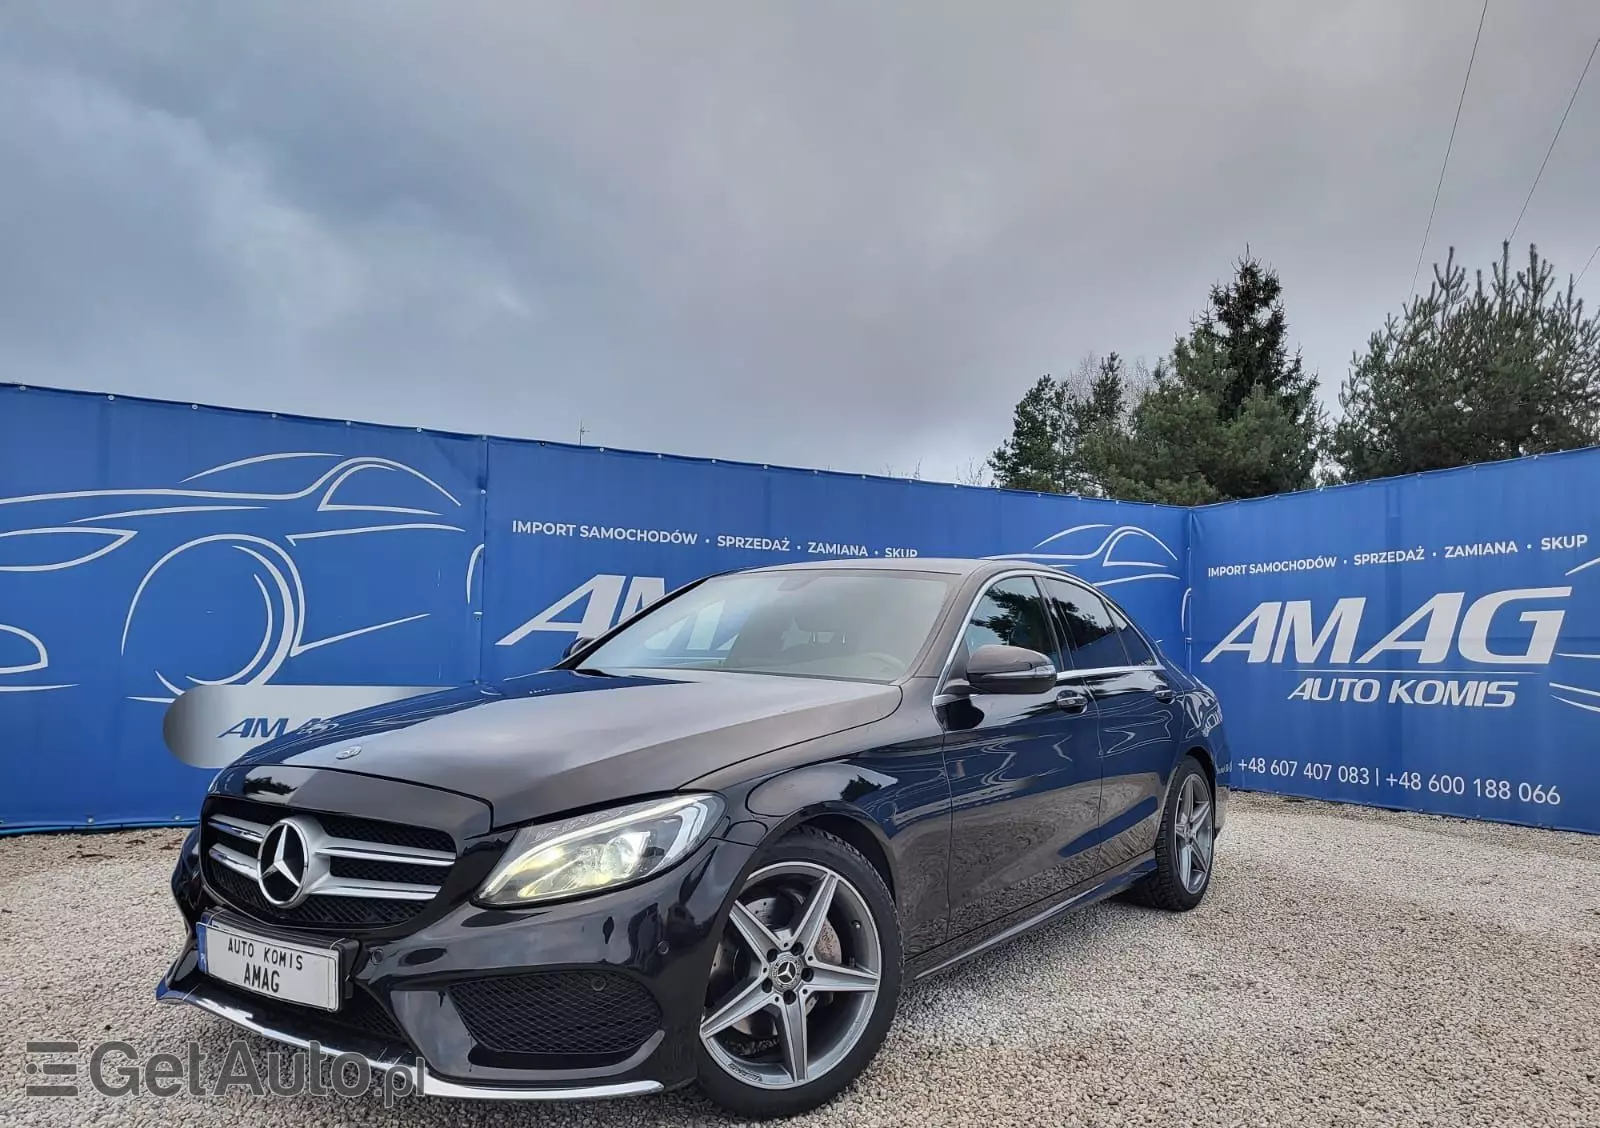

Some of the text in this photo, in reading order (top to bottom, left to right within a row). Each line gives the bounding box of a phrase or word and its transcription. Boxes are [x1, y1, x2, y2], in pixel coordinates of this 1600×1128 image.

[512, 520, 918, 558] IMPORT SAMOCHODÓW SPRZEDAŻ ZAMIANA SKUP
[1208, 534, 1588, 578] IMPORT SAMOCHODÓW SPRZEDAŻ ZAMIANA SKUP
[1201, 586, 1573, 665] AMAG
[1287, 678, 1519, 707] AUTO KOMIS
[1238, 757, 1266, 775] +48
[1270, 759, 1298, 777] 607
[1303, 762, 1332, 781] 407
[1338, 765, 1370, 785] 083
[1385, 771, 1422, 790] +48
[1428, 774, 1465, 795] 600
[1473, 778, 1511, 800] 188
[1518, 782, 1561, 805] 066
[228, 937, 304, 971] AUTO KOMIS
[243, 963, 281, 993] AMAG
